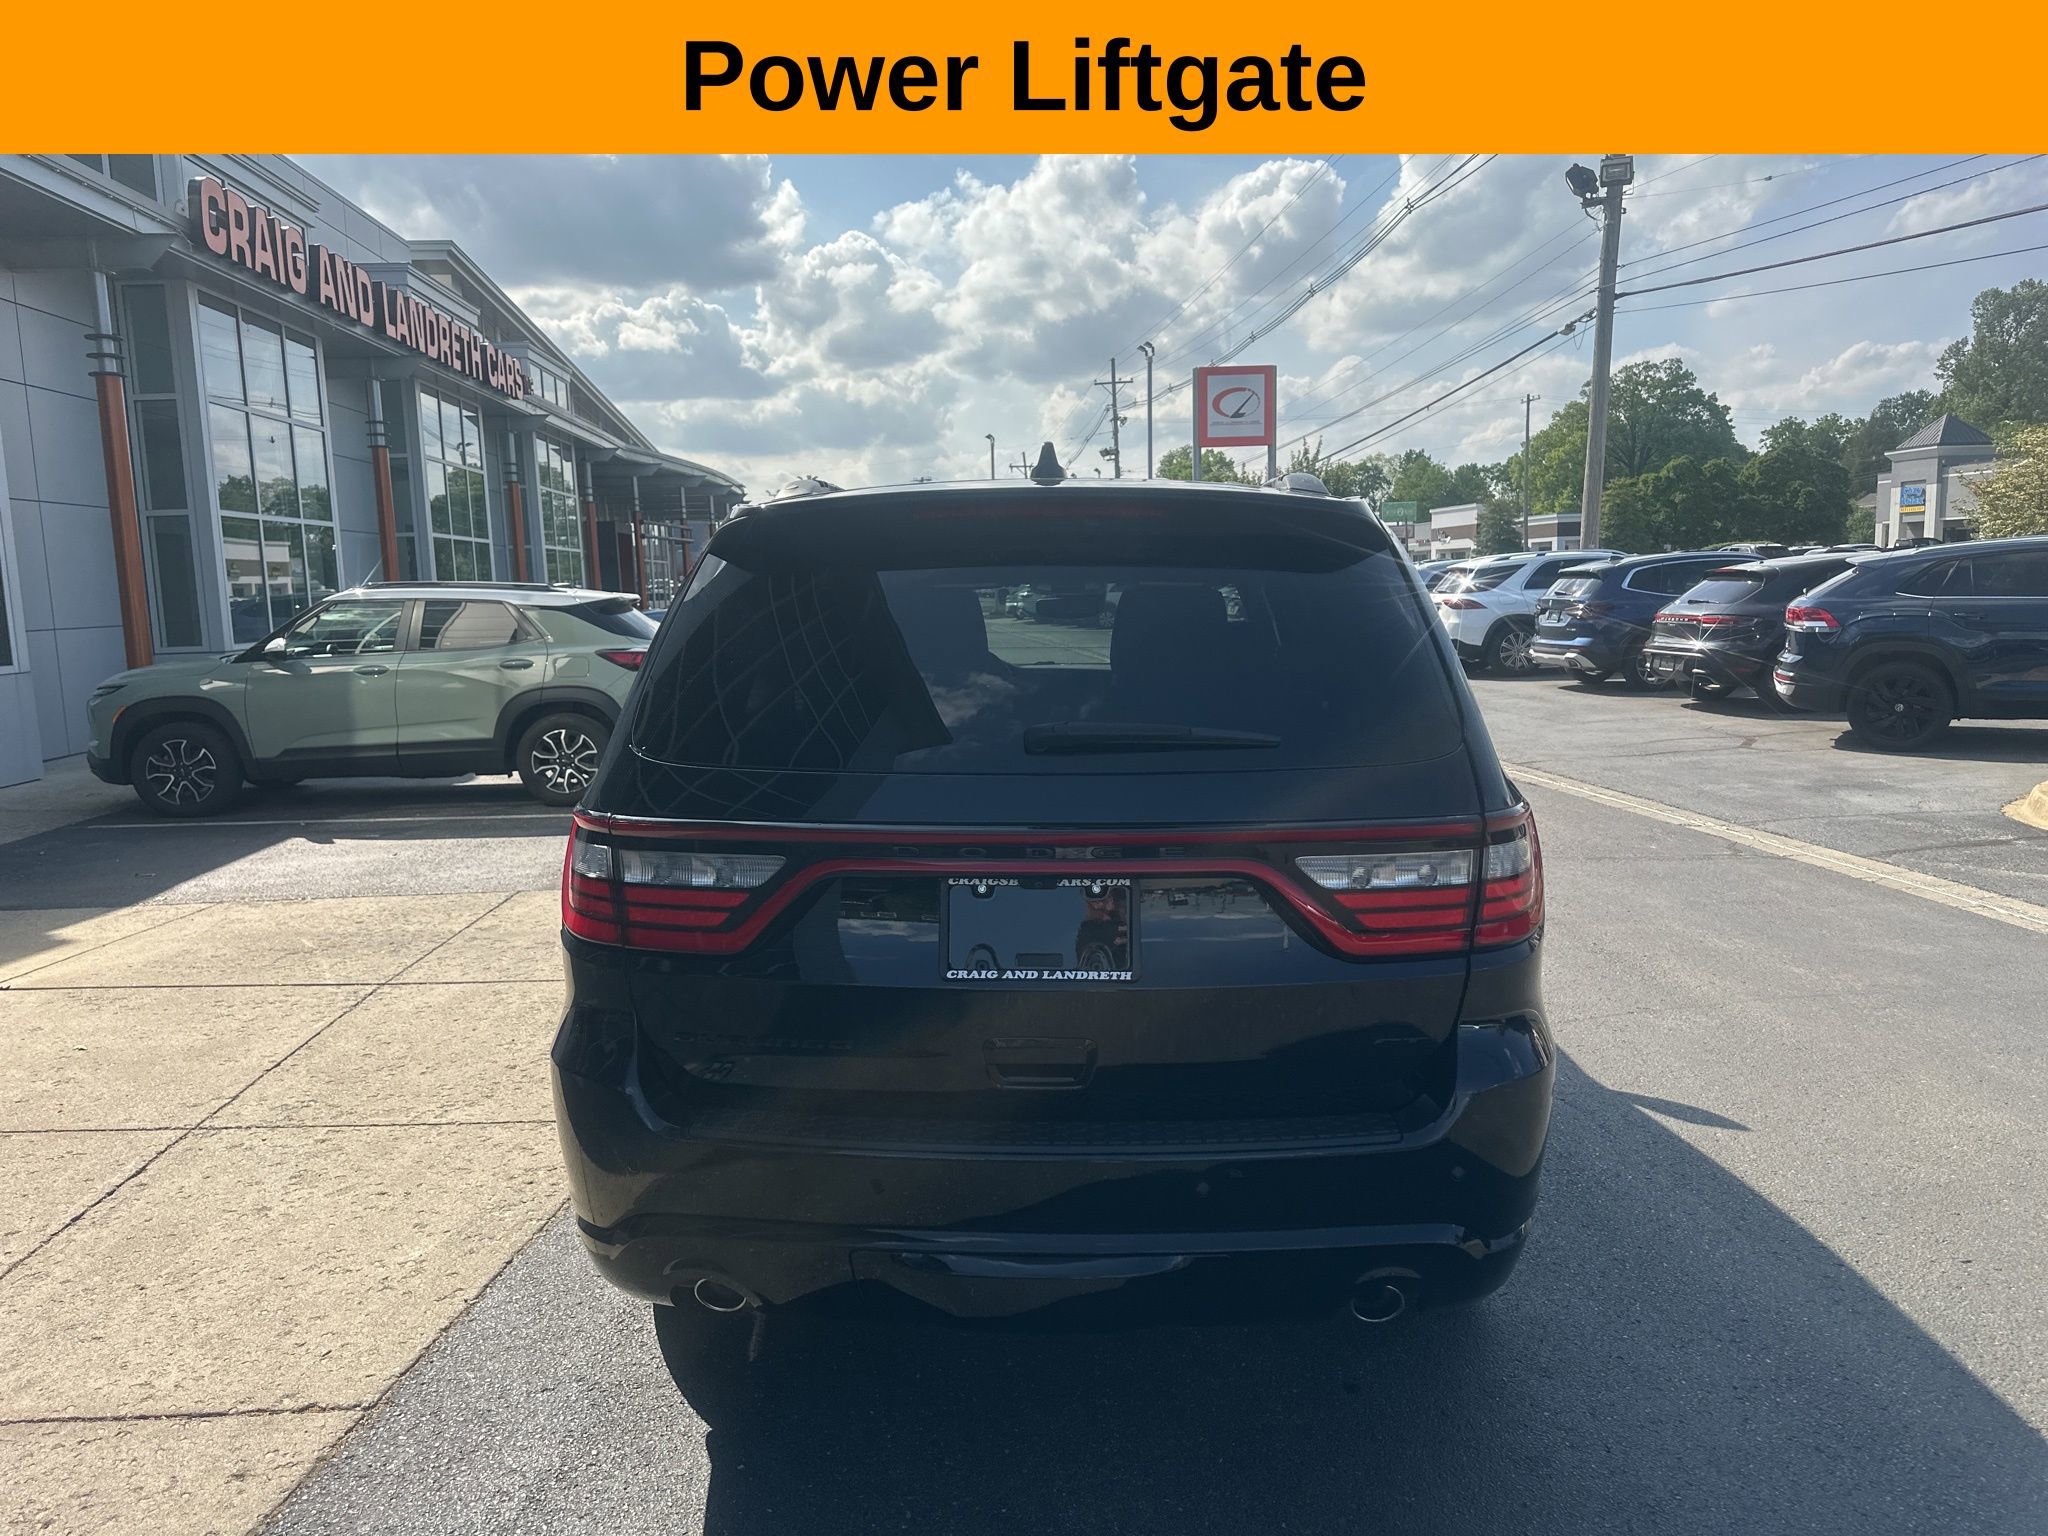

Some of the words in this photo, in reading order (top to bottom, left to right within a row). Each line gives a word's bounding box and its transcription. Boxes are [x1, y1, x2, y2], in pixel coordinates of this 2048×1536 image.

[200, 176, 308, 295] CRAIG
[319, 246, 375, 329] AND
[382, 280, 484, 381] LANDRETH
[485, 342, 526, 400] CARS
[946, 970, 999, 979] CRAIG
[1001, 970, 1039, 980] AND
[1042, 970, 1133, 981] LANDRETH
